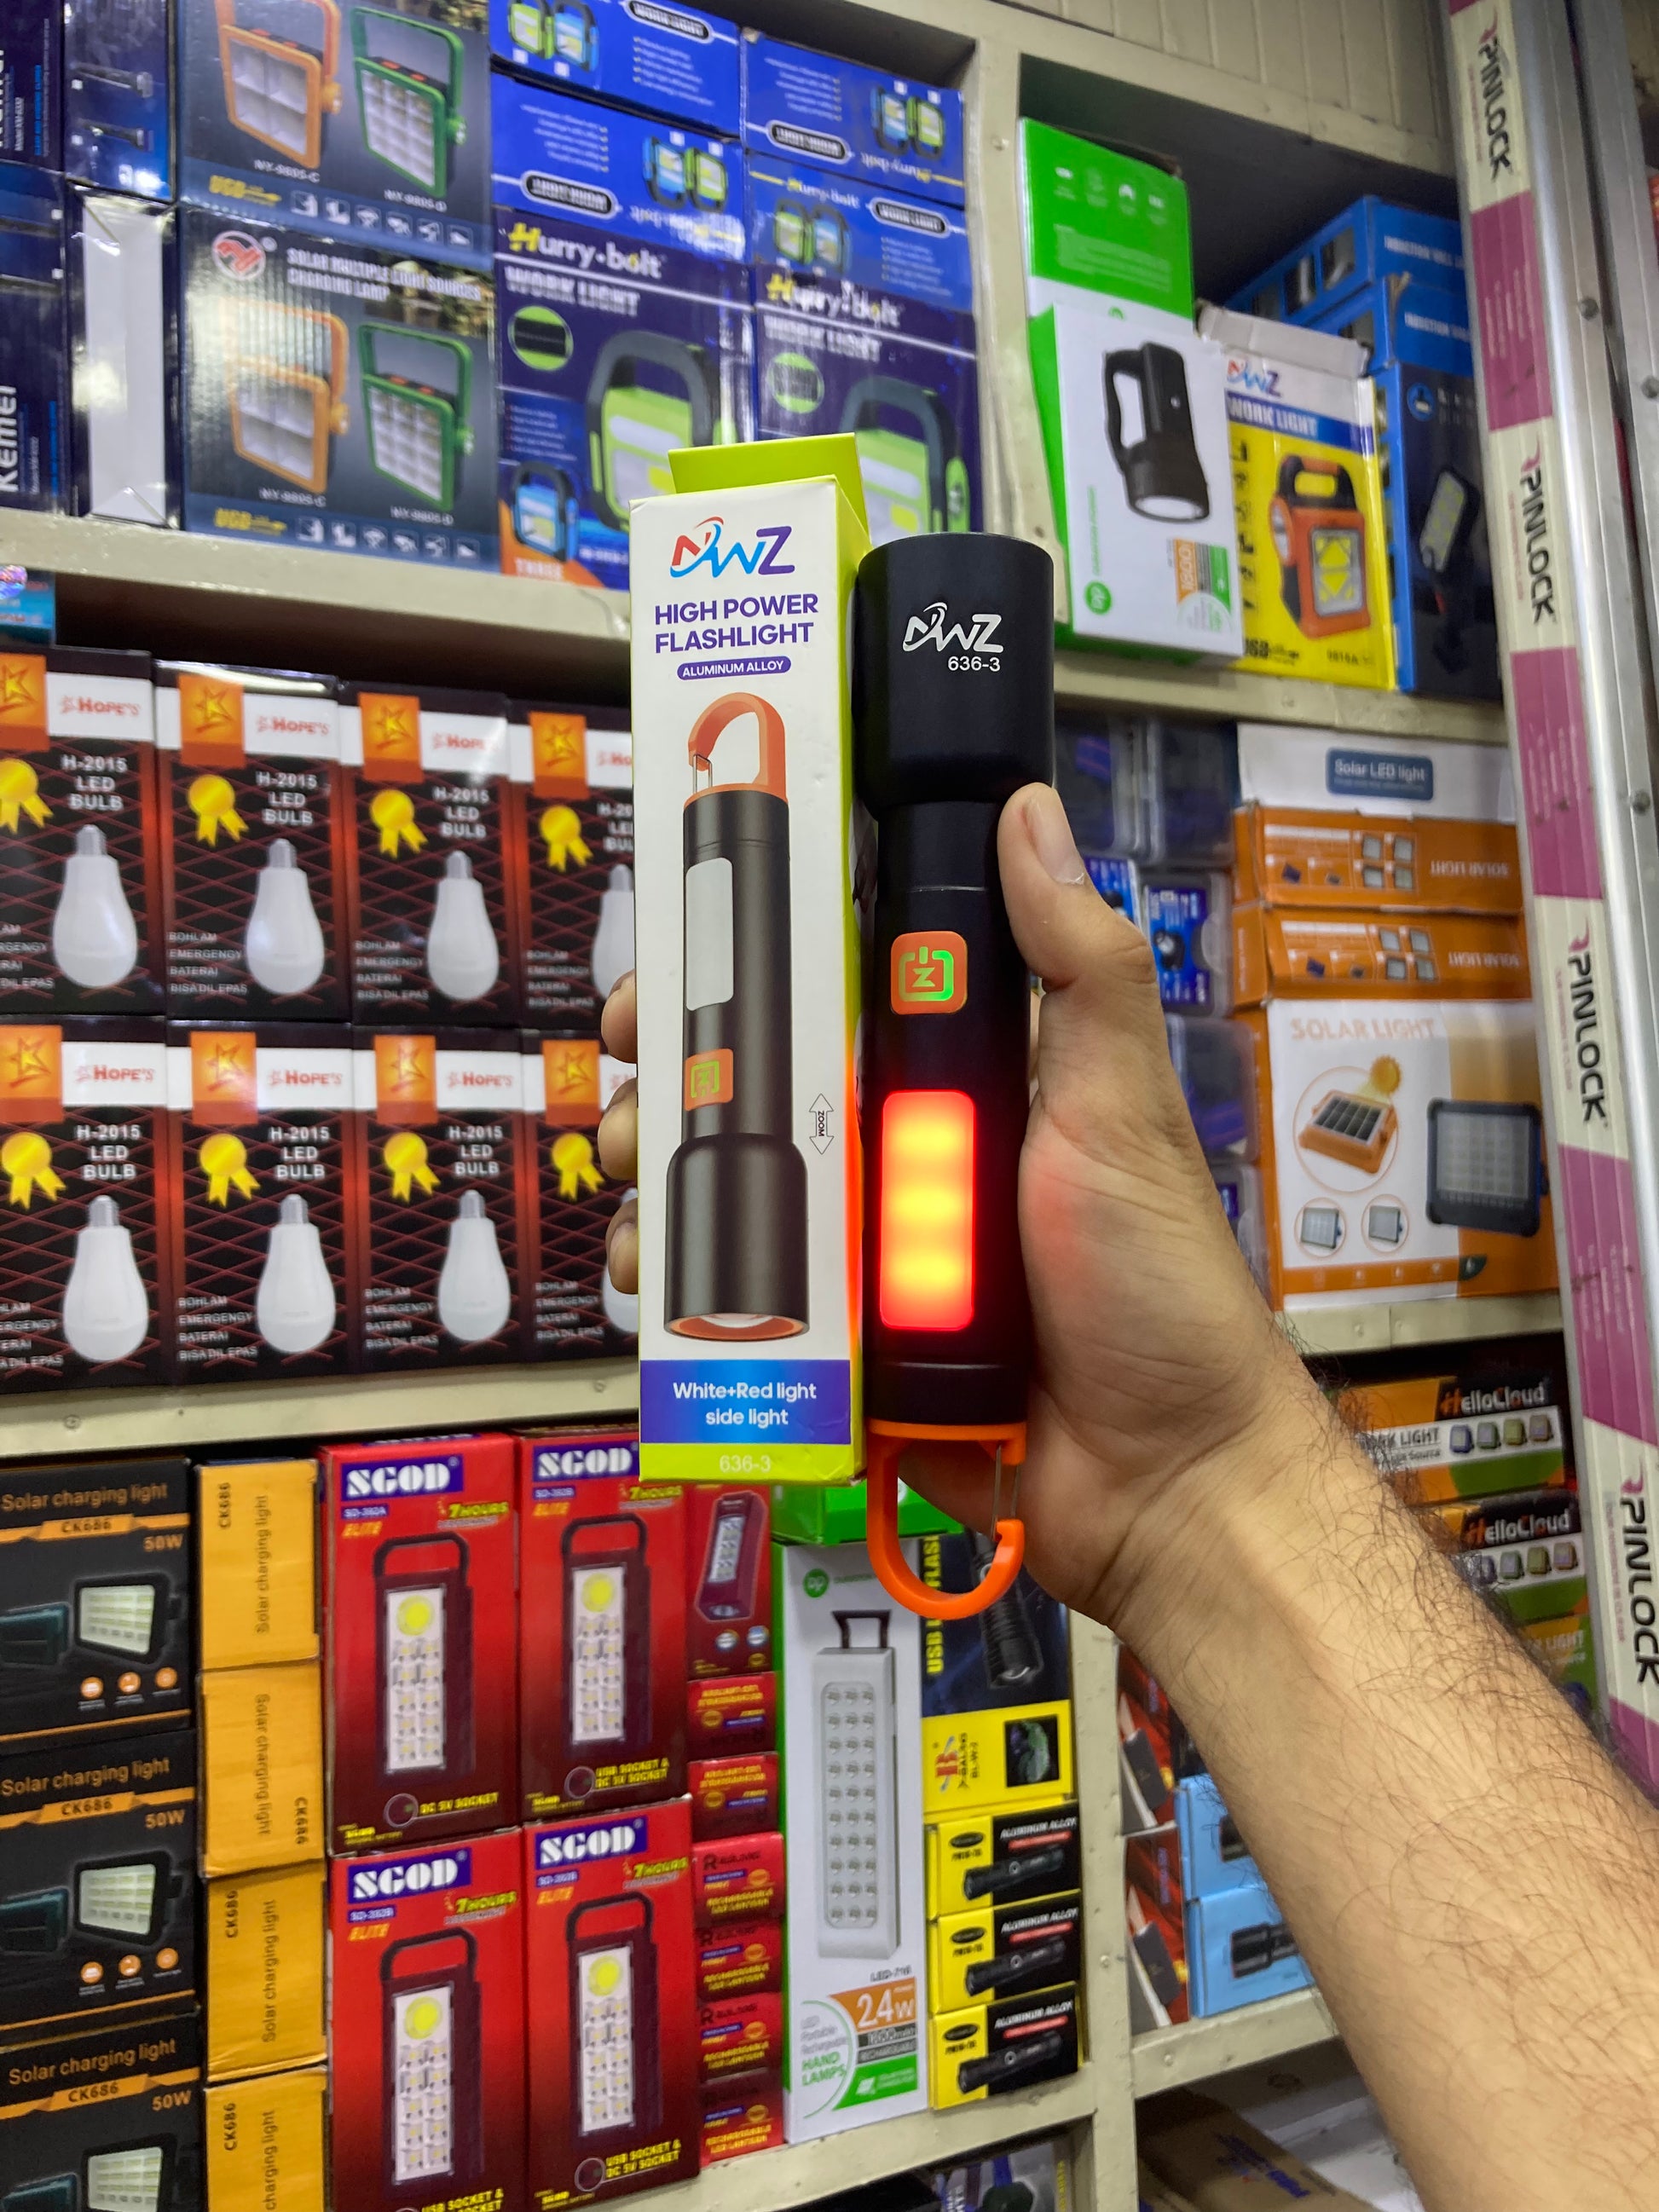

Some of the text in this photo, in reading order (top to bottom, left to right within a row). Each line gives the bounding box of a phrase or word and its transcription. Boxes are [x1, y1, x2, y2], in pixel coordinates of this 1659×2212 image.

[1478, 37, 1512, 182] PINLOCK
[1230, 396, 1317, 437] WORK LIGHT
[1520, 466, 1557, 625] PINLOCK
[655, 593, 818, 625] HIGH POWER
[655, 622, 814, 653] FLASHLIGHT
[683, 660, 784, 677] ALUMINUM ALLOY
[948, 656, 1001, 672] 636-3
[61, 755, 128, 772] H-2015
[1335, 759, 1425, 782] Solar LED light
[75, 775, 115, 793] LED
[257, 771, 317, 789] H-2015
[69, 794, 124, 811] BULB
[269, 791, 306, 807] LED
[432, 787, 489, 805] H-2015
[262, 808, 313, 826] BULB
[446, 806, 479, 822] LED
[598, 804, 633, 818] H-20
[439, 823, 486, 839] BULB
[604, 837, 634, 852] BUL
[1292, 1017, 1435, 1041] SOLAR LIGHT
[1568, 951, 1606, 1123] PINLOCK
[94, 1065, 154, 1082] HOPE'S
[285, 1070, 343, 1086] HOPE'S
[77, 1123, 141, 1141] H-2015
[269, 1126, 330, 1142] H-2015
[449, 1125, 503, 1140] H-2015
[817, 1111, 825, 1137] ZOOM
[90, 1144, 128, 1161] LED
[281, 1146, 319, 1161] LED
[460, 1144, 493, 1158] LED
[83, 1164, 136, 1181] BULB
[275, 1164, 326, 1181] BULB
[454, 1162, 500, 1176] BULB
[673, 1380, 817, 1402] White+Red light
[1441, 1382, 1545, 1416] HelloCloud
[705, 1407, 789, 1429] side light
[1400, 1427, 1439, 1446] LIGHT
[719, 1454, 772, 1473] 636-3
[1, 1482, 168, 1512] Solar charging light
[217, 1481, 231, 1530] CK686
[1465, 1508, 1569, 1545] HelloCloud
[143, 1533, 183, 1552] 50W
[255, 1494, 272, 1634] Solar charging light
[1621, 1498, 1659, 1685] PINLOCK
[926, 1631, 944, 1675] USB
[1, 1757, 170, 1797] Solar charging light
[253, 1736, 269, 1799] charging
[61, 1798, 113, 1816] CK686
[145, 1809, 185, 1829] 50W
[254, 1802, 272, 1836] light
[1000, 1816, 1078, 1840] ALUMINUM ALLOY
[225, 1890, 238, 1938] CK686
[1001, 1907, 1078, 1933] ALUMINUM ALLOY
[263, 1899, 280, 2043] Solar charging light
[994, 2001, 1073, 2029] ALUMINUM ALLOY
[9, 2038, 176, 2085] Solar charging light
[802, 2051, 841, 2071] HAND
[802, 2065, 847, 2086] LAMPS
[68, 2082, 119, 2103] CK686
[152, 2090, 192, 2111] 50W
[224, 2103, 237, 2151] CK686
[263, 2110, 280, 2211] charging light
[606, 2153, 627, 2166] USB
[629, 2143, 671, 2160] SOCKET
[639, 2151, 679, 2169] SOCKET
